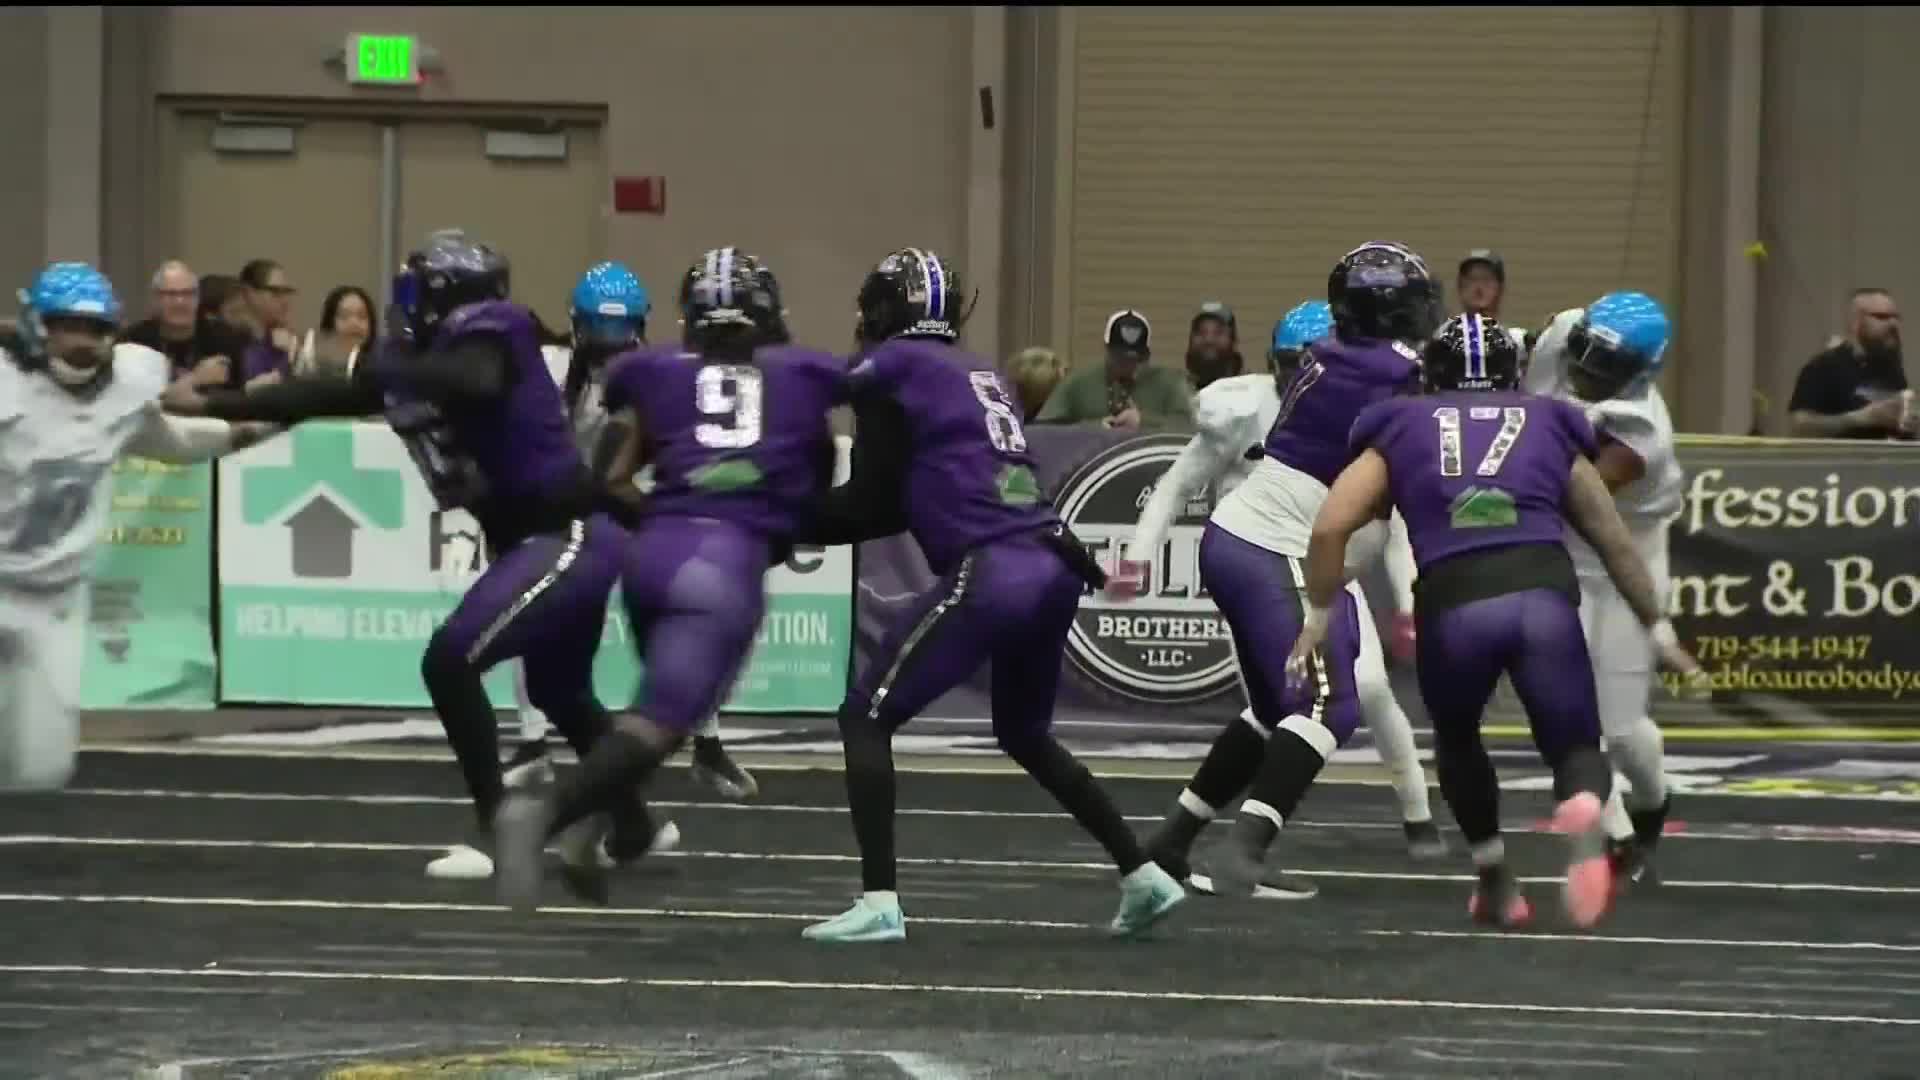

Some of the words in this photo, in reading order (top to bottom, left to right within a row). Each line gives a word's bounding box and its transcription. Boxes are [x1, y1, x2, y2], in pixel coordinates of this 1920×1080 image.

[358, 36, 410, 79] EXIT
[695, 364, 762, 448] 9
[1432, 407, 1526, 476] 17
[1678, 468, 1920, 536] fession
[1762, 560, 1808, 616] &
[1824, 556, 1920, 617] Bo
[1696, 635, 1872, 660] 719-544-1947
